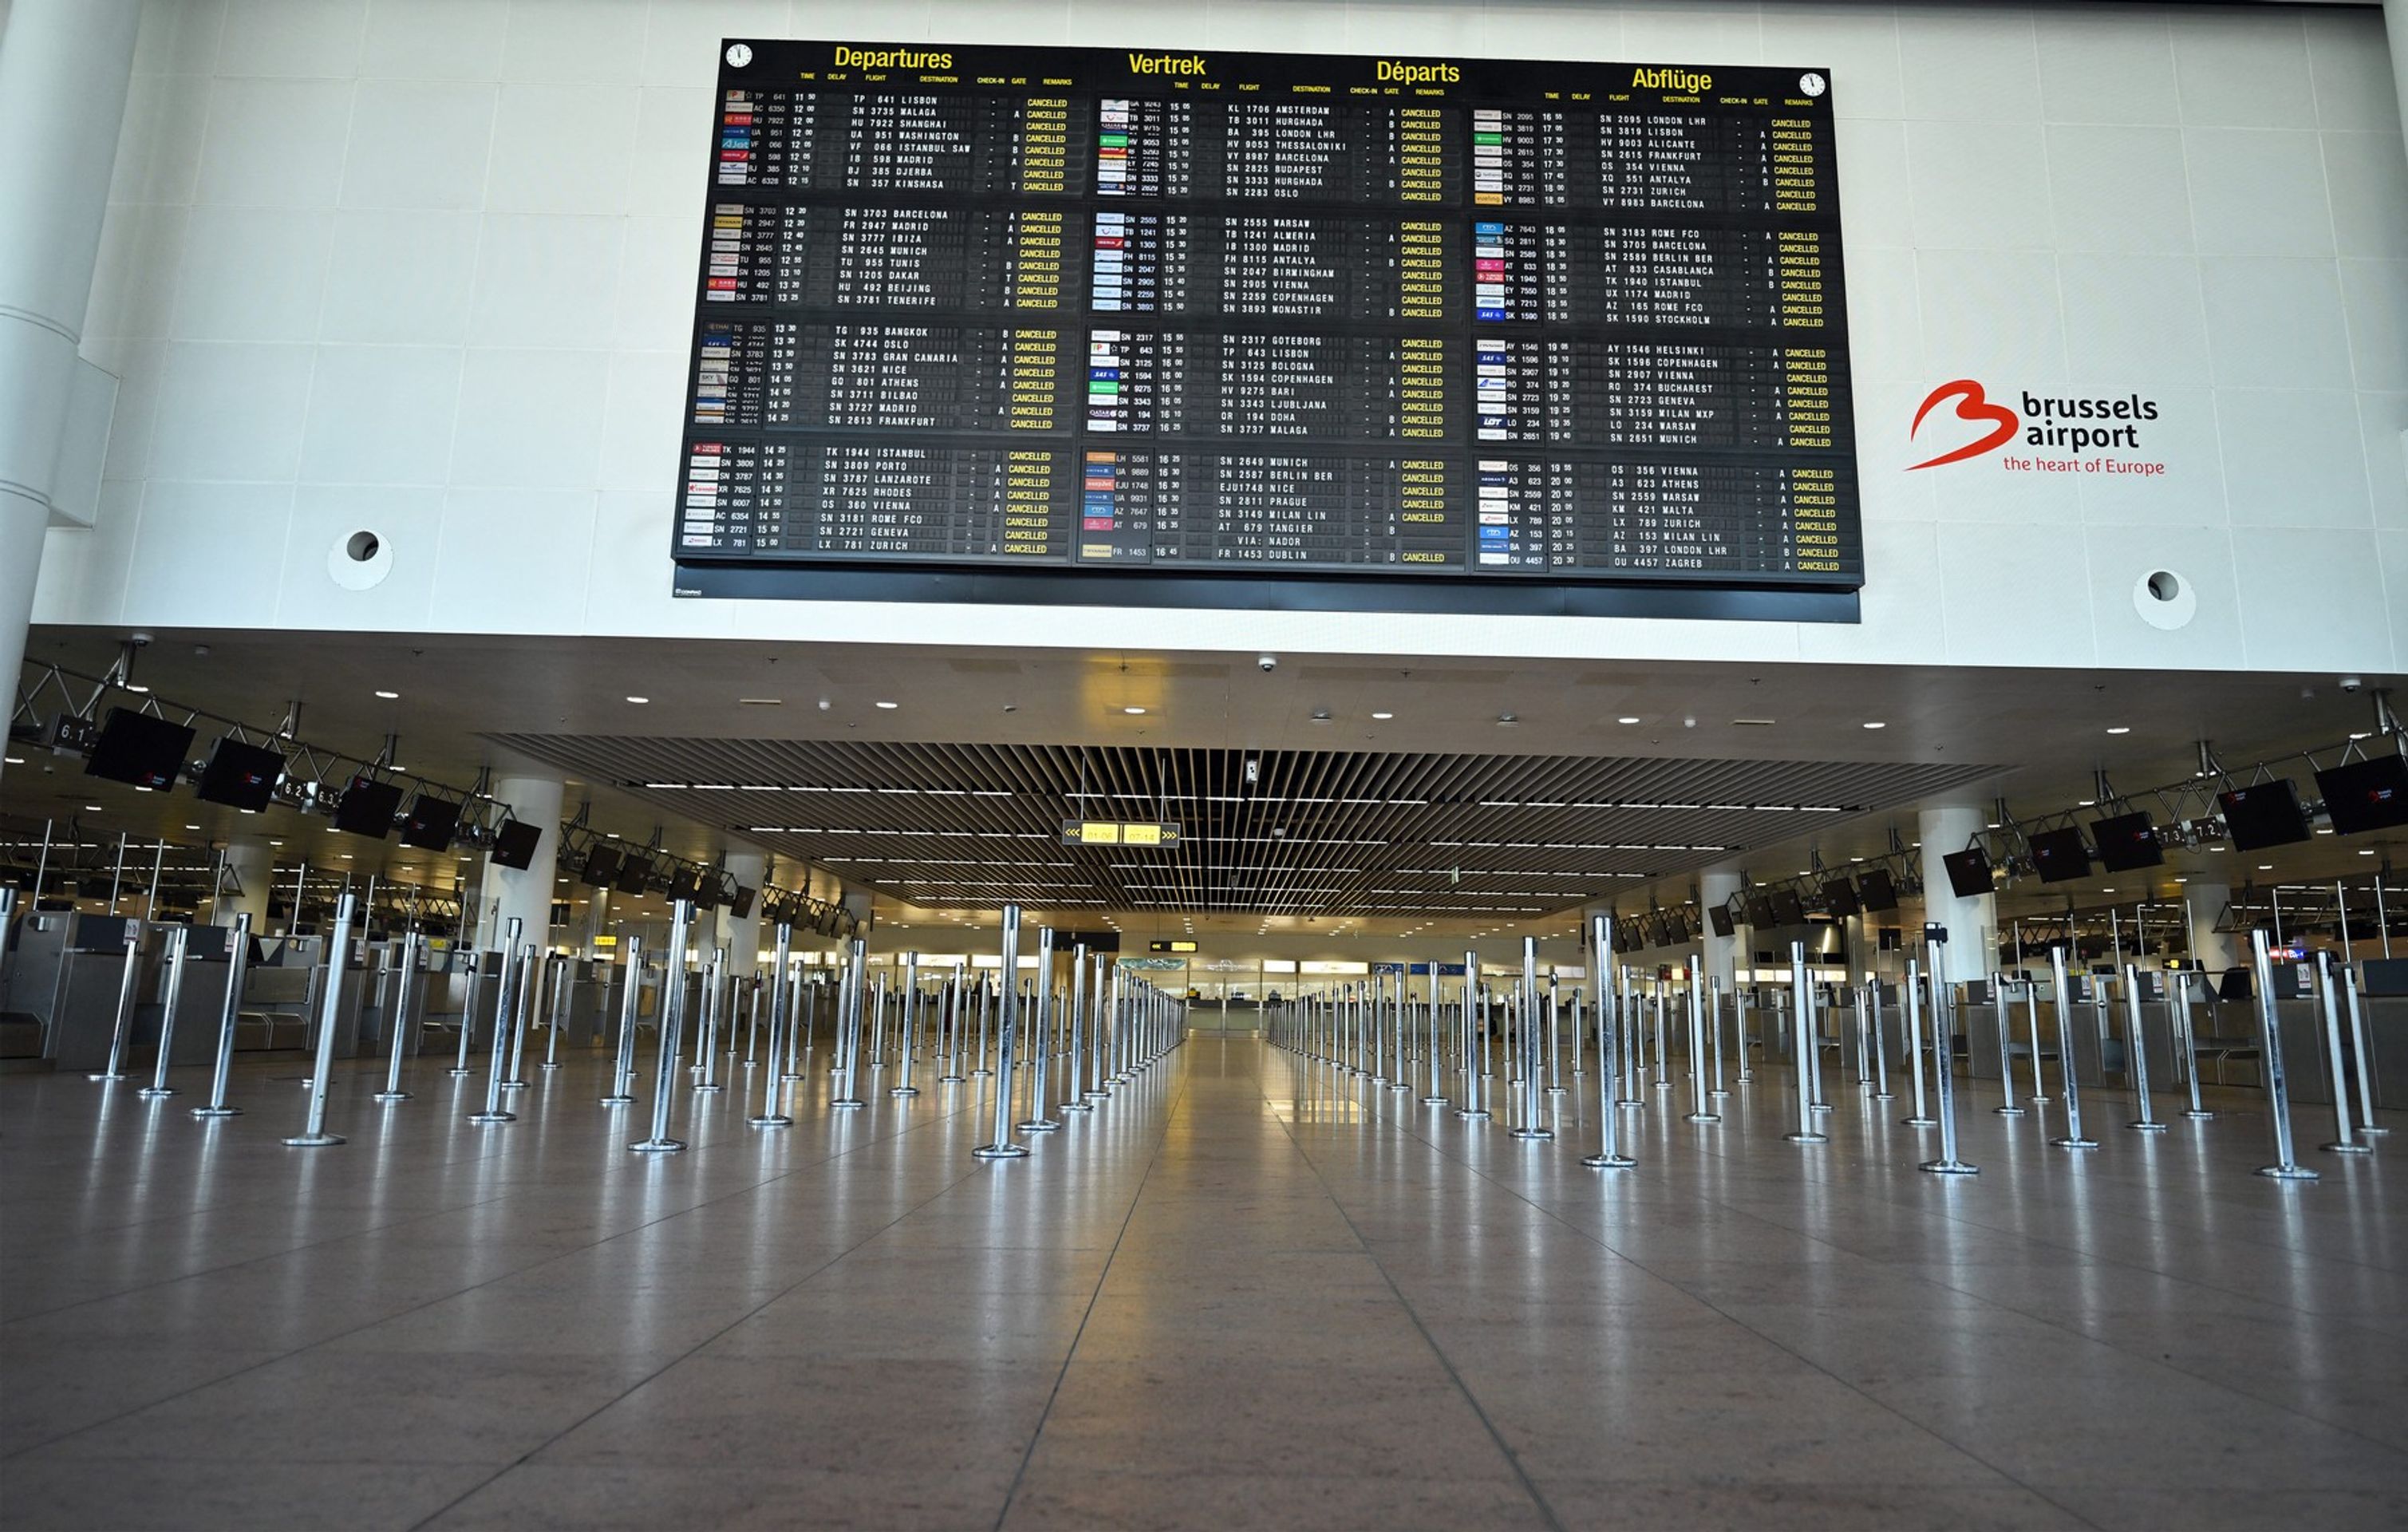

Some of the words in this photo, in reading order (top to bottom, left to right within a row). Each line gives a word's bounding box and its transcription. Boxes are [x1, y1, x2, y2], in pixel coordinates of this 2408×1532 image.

[835, 47, 952, 70] Departures
[1130, 54, 1206, 74] Vertrek
[1378, 61, 1459, 85] Départs
[1632, 69, 1711, 93] Abflüge
[1401, 120, 1440, 129] CANCELLED
[899, 132, 958, 140] WASHINGTON
[1026, 134, 1065, 143] CANCELLED
[1277, 141, 1345, 150] THESSALONIKI
[1401, 144, 1441, 153] CANCELLED
[1648, 140, 1694, 148] ALICANTE
[1773, 143, 1812, 152] CANCELLED
[1402, 168, 1441, 177] CANCELLED
[1651, 199, 1703, 208] BARCELONA
[894, 210, 947, 219] BARCELONA
[1274, 231, 1315, 240] ALMERIA
[1605, 227, 1615, 236] SN
[1778, 232, 1818, 241] CANCELLED
[890, 247, 926, 255] MUNICH
[1273, 268, 1333, 277] BIRMINGHAM
[1402, 271, 1442, 280] CANCELLED
[1654, 266, 1713, 274] CASABLANCA
[1781, 269, 1820, 278] CANCELLED
[1656, 278, 1701, 287] ISTANBUL
[1781, 281, 1822, 290] CANCELLED
[888, 296, 935, 305] TENERIFE
[1273, 293, 1333, 302] COPENHAGEN
[1656, 315, 1710, 324] STOCKHOLM
[885, 327, 927, 336] BANGKOK
[1016, 330, 1056, 339] CANCELLED
[884, 340, 908, 349] OSLO
[1273, 336, 1320, 345] GOTEBORG
[1402, 339, 1443, 348] CANCELLED
[1402, 352, 1443, 361] CANCELLED
[1656, 345, 1703, 354] HELSINKI
[1785, 349, 1826, 357] CANCELLED
[1657, 358, 1717, 368] COPENHAGEN
[1786, 361, 1826, 370] CANCELLED
[882, 378, 918, 387] ATHENS
[1658, 384, 1712, 393] BUCHAREST
[1402, 403, 1443, 412] CANCELLED
[2023, 391, 2157, 420] brussels
[879, 417, 934, 425] FRANKFURT
[1011, 420, 1052, 428] CANCELLED
[1790, 425, 1830, 434] CANCELLED
[2027, 420, 2139, 453] airport
[878, 448, 925, 458] ISTANBUL
[1009, 452, 1051, 460] CANCELLED
[876, 462, 906, 471] PORTO
[1009, 465, 1050, 474] CANCELLED
[1270, 458, 1307, 467] MUNICH
[1403, 460, 1443, 469] CANCELLED
[2004, 456, 2031, 471] the
[2036, 457, 2080, 472] heart
[2086, 458, 2101, 472] of
[2106, 460, 2164, 476] Europe
[1661, 467, 1698, 476] VIENNA
[875, 475, 930, 484] LANZAROTE
[1008, 478, 1049, 487] CANCELLED
[1270, 497, 1306, 506] PRAGUE
[1663, 506, 1693, 515] MALTA
[1664, 532, 1694, 541] MILAN
[870, 541, 907, 550] ZURICH
[1005, 544, 1047, 553] CANCELLED
[1269, 550, 1306, 559] DUBLIN
[1403, 553, 1444, 562] CANCELLED
[1666, 559, 1702, 567] ZAGREB
[1798, 562, 1839, 571] CANCELLED
